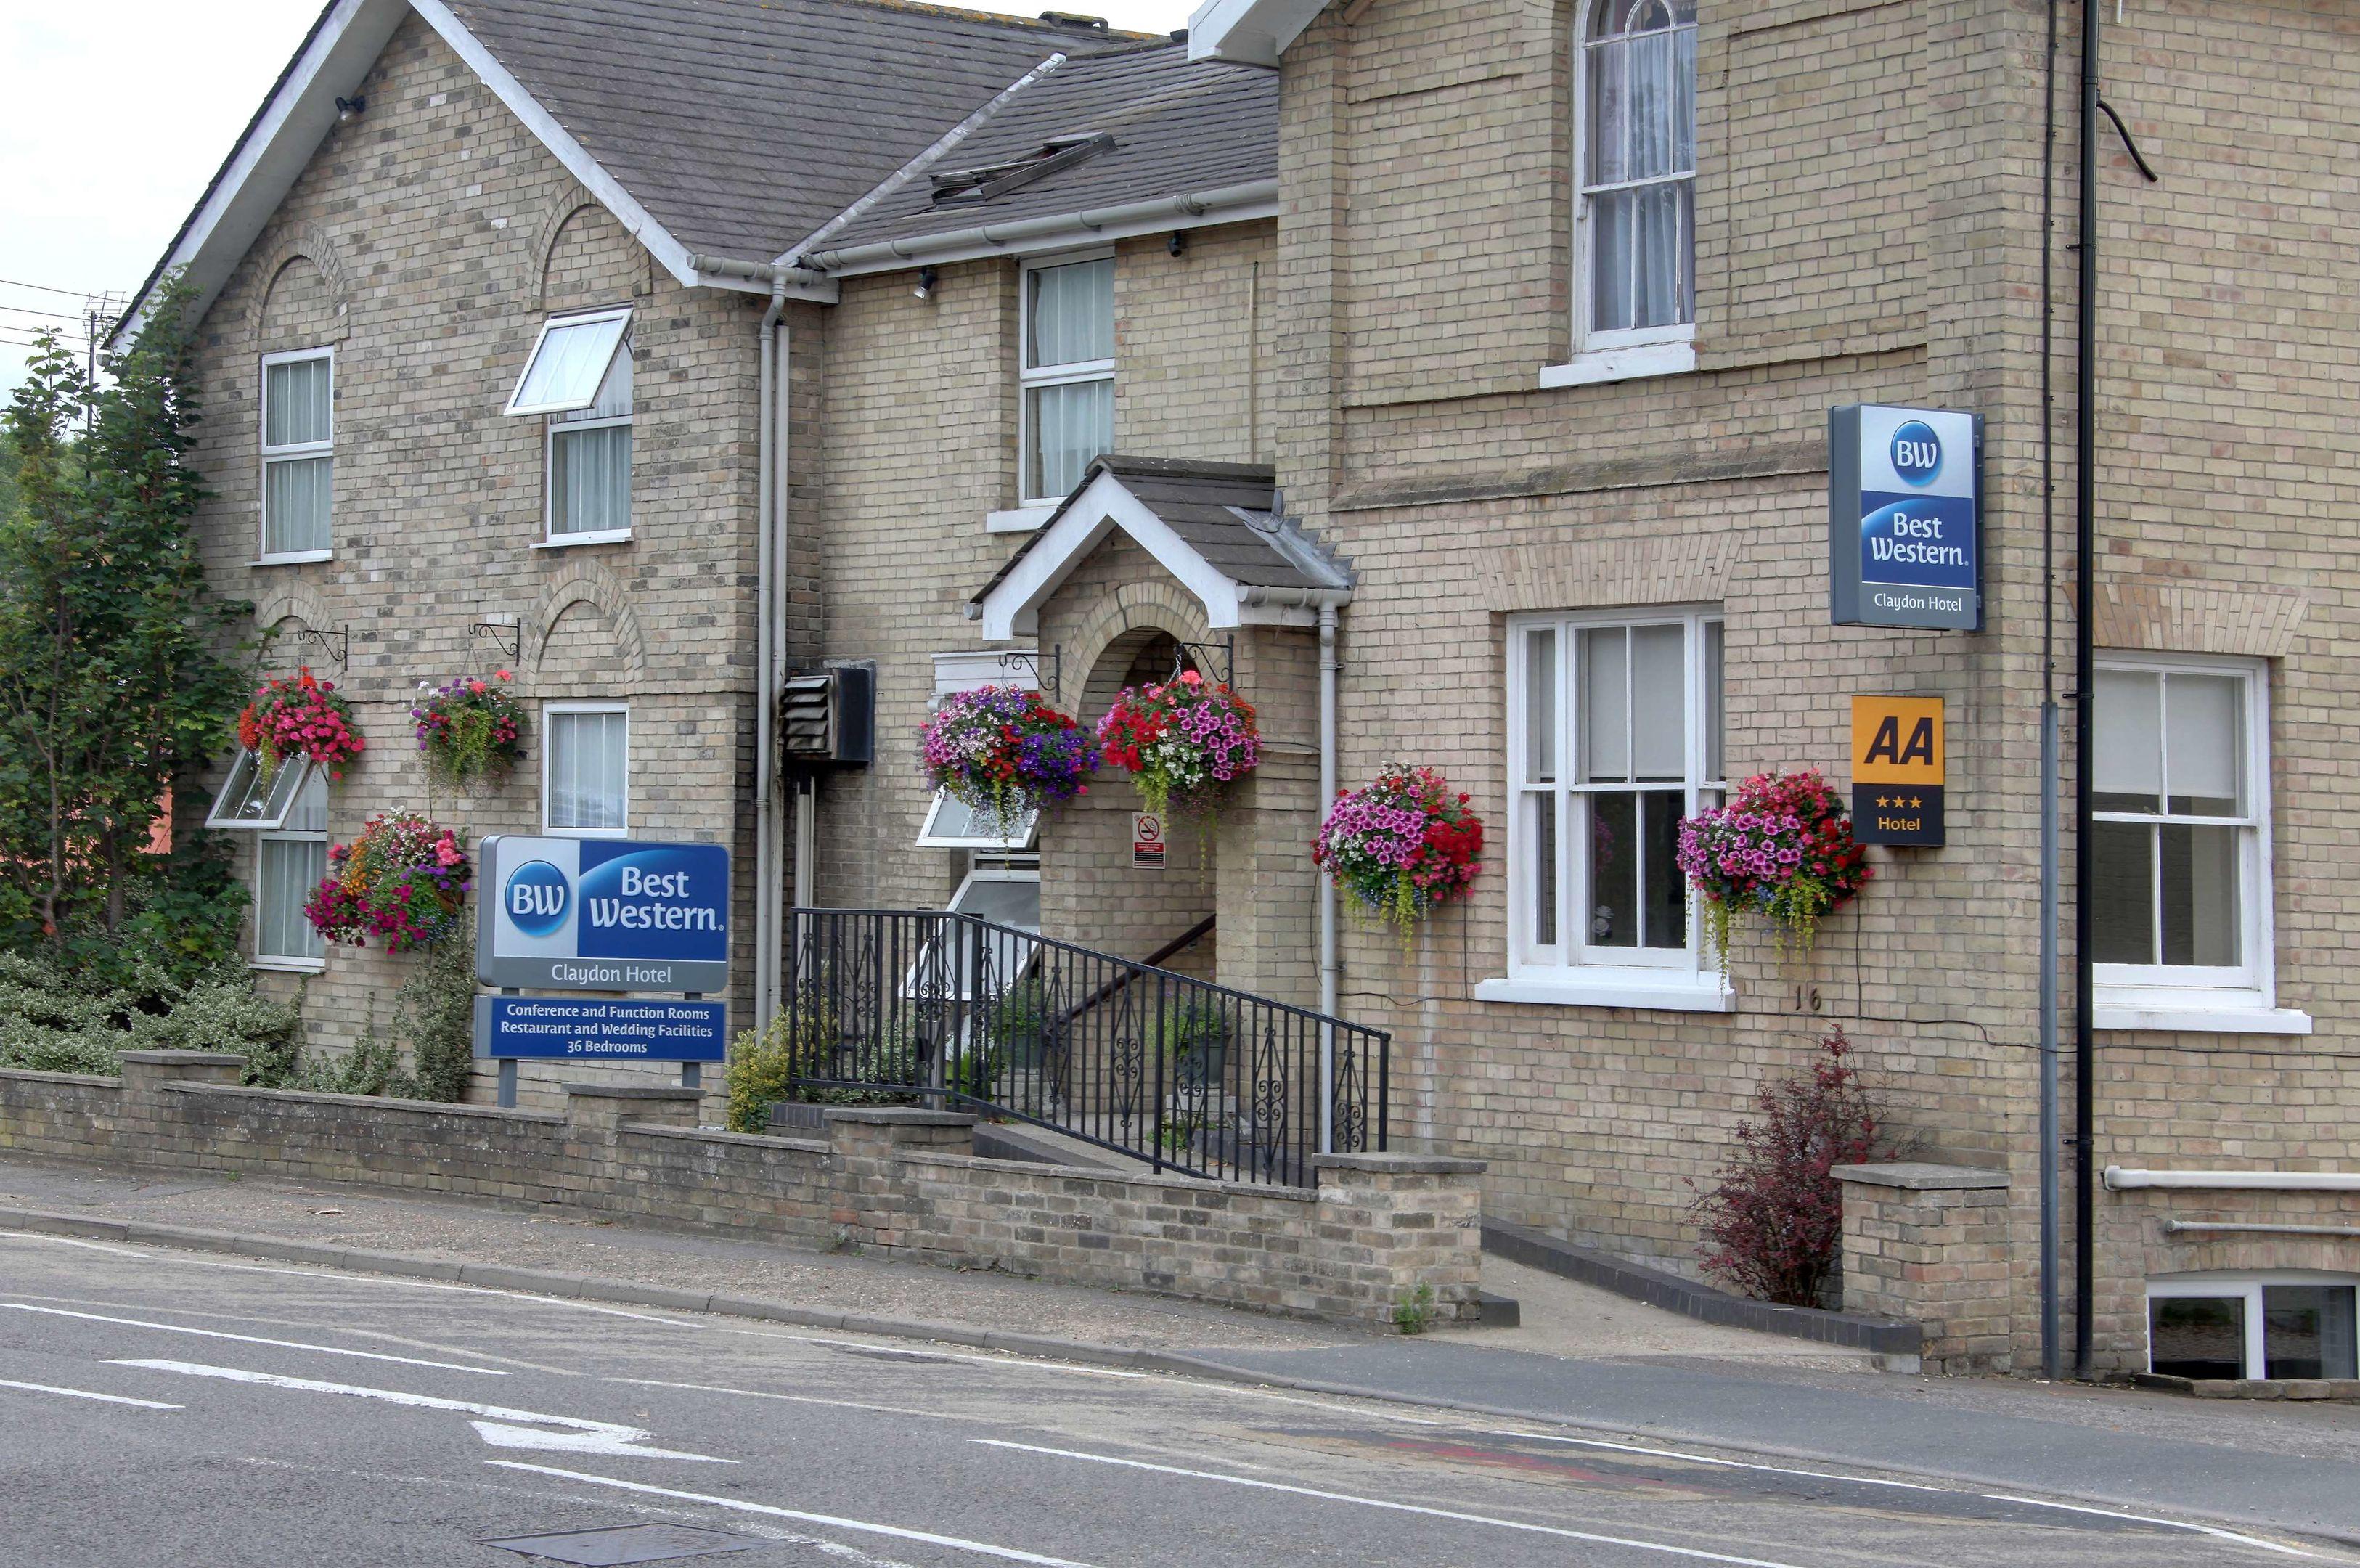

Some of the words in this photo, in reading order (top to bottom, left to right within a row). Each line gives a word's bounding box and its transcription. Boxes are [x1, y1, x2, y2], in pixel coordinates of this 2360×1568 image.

[1897, 441, 1937, 468] BW
[1894, 513, 1943, 539] Best
[1871, 537, 1964, 565] Western
[1874, 593, 1924, 611] Claydon
[1929, 597, 1961, 611] Hotel
[1863, 716, 1933, 765] AA
[1878, 817, 1920, 830] Hotel
[622, 867, 690, 898] Best
[513, 884, 565, 915] BW
[590, 898, 717, 931] Western
[552, 964, 620, 984] Claydon
[626, 966, 671, 982] Hotel
[1795, 985, 1821, 1010] 16
[507, 1004, 579, 1017] Conference
[582, 1006, 605, 1018] and
[610, 1006, 664, 1019] Function
[669, 1008, 709, 1020] Rooms
[501, 1022, 571, 1034] Restaurant
[574, 1023, 598, 1034] and
[602, 1024, 655, 1038] Wedding
[658, 1025, 713, 1037] Facilities
[568, 1040, 581, 1053] 36
[585, 1041, 647, 1053] Bedrooms
